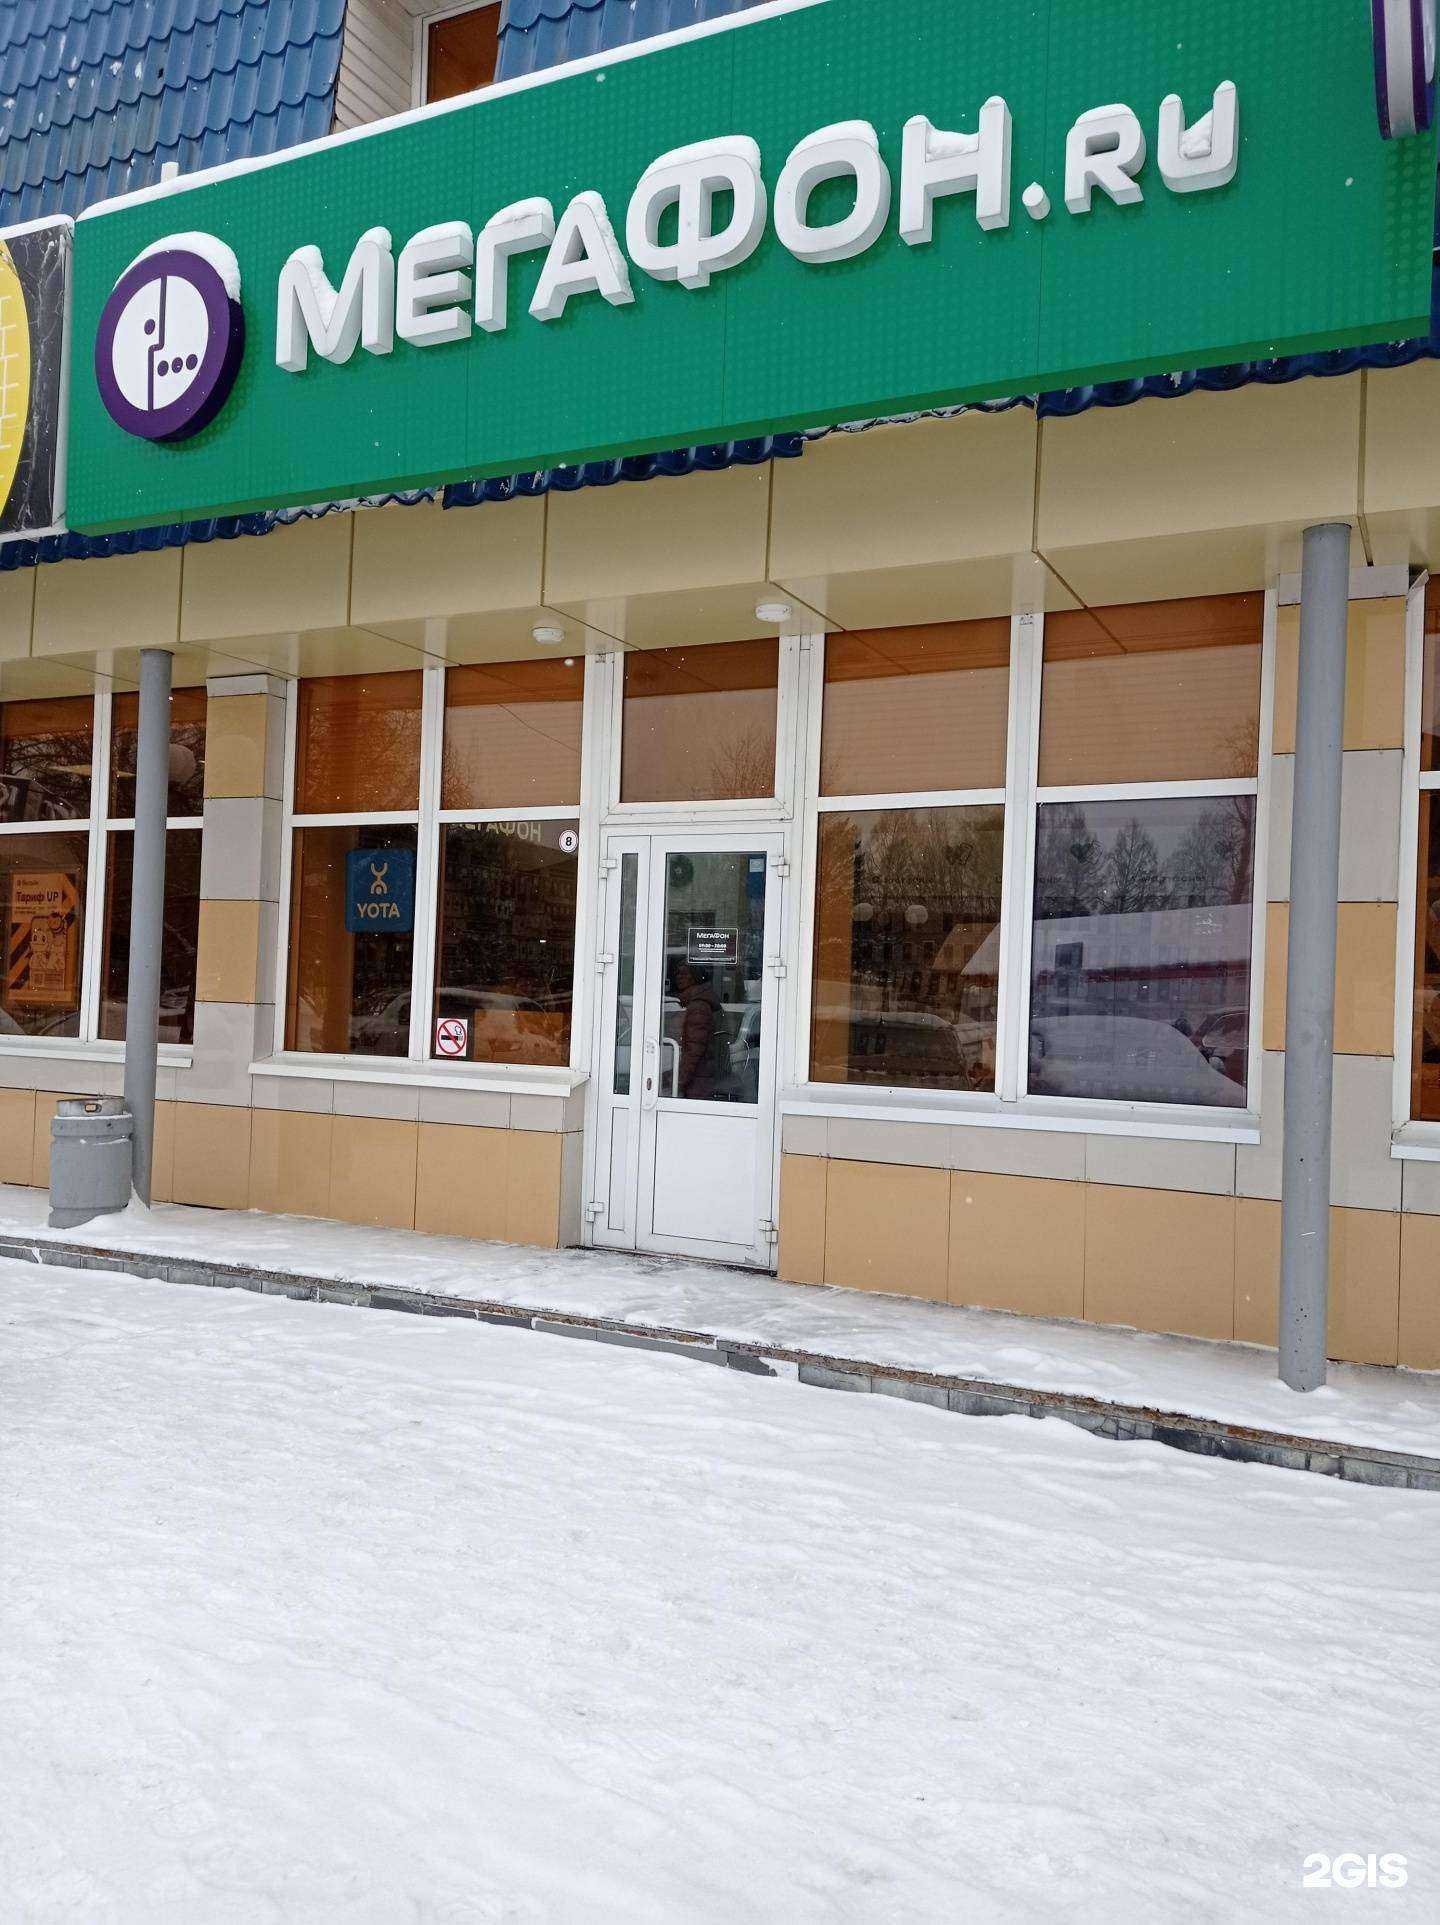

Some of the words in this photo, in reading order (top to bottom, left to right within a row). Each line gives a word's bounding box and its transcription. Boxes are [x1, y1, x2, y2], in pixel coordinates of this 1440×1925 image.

[16, 891, 45, 904] Тариф
[46, 890, 59, 903] UP
[357, 902, 401, 918] YOTA
